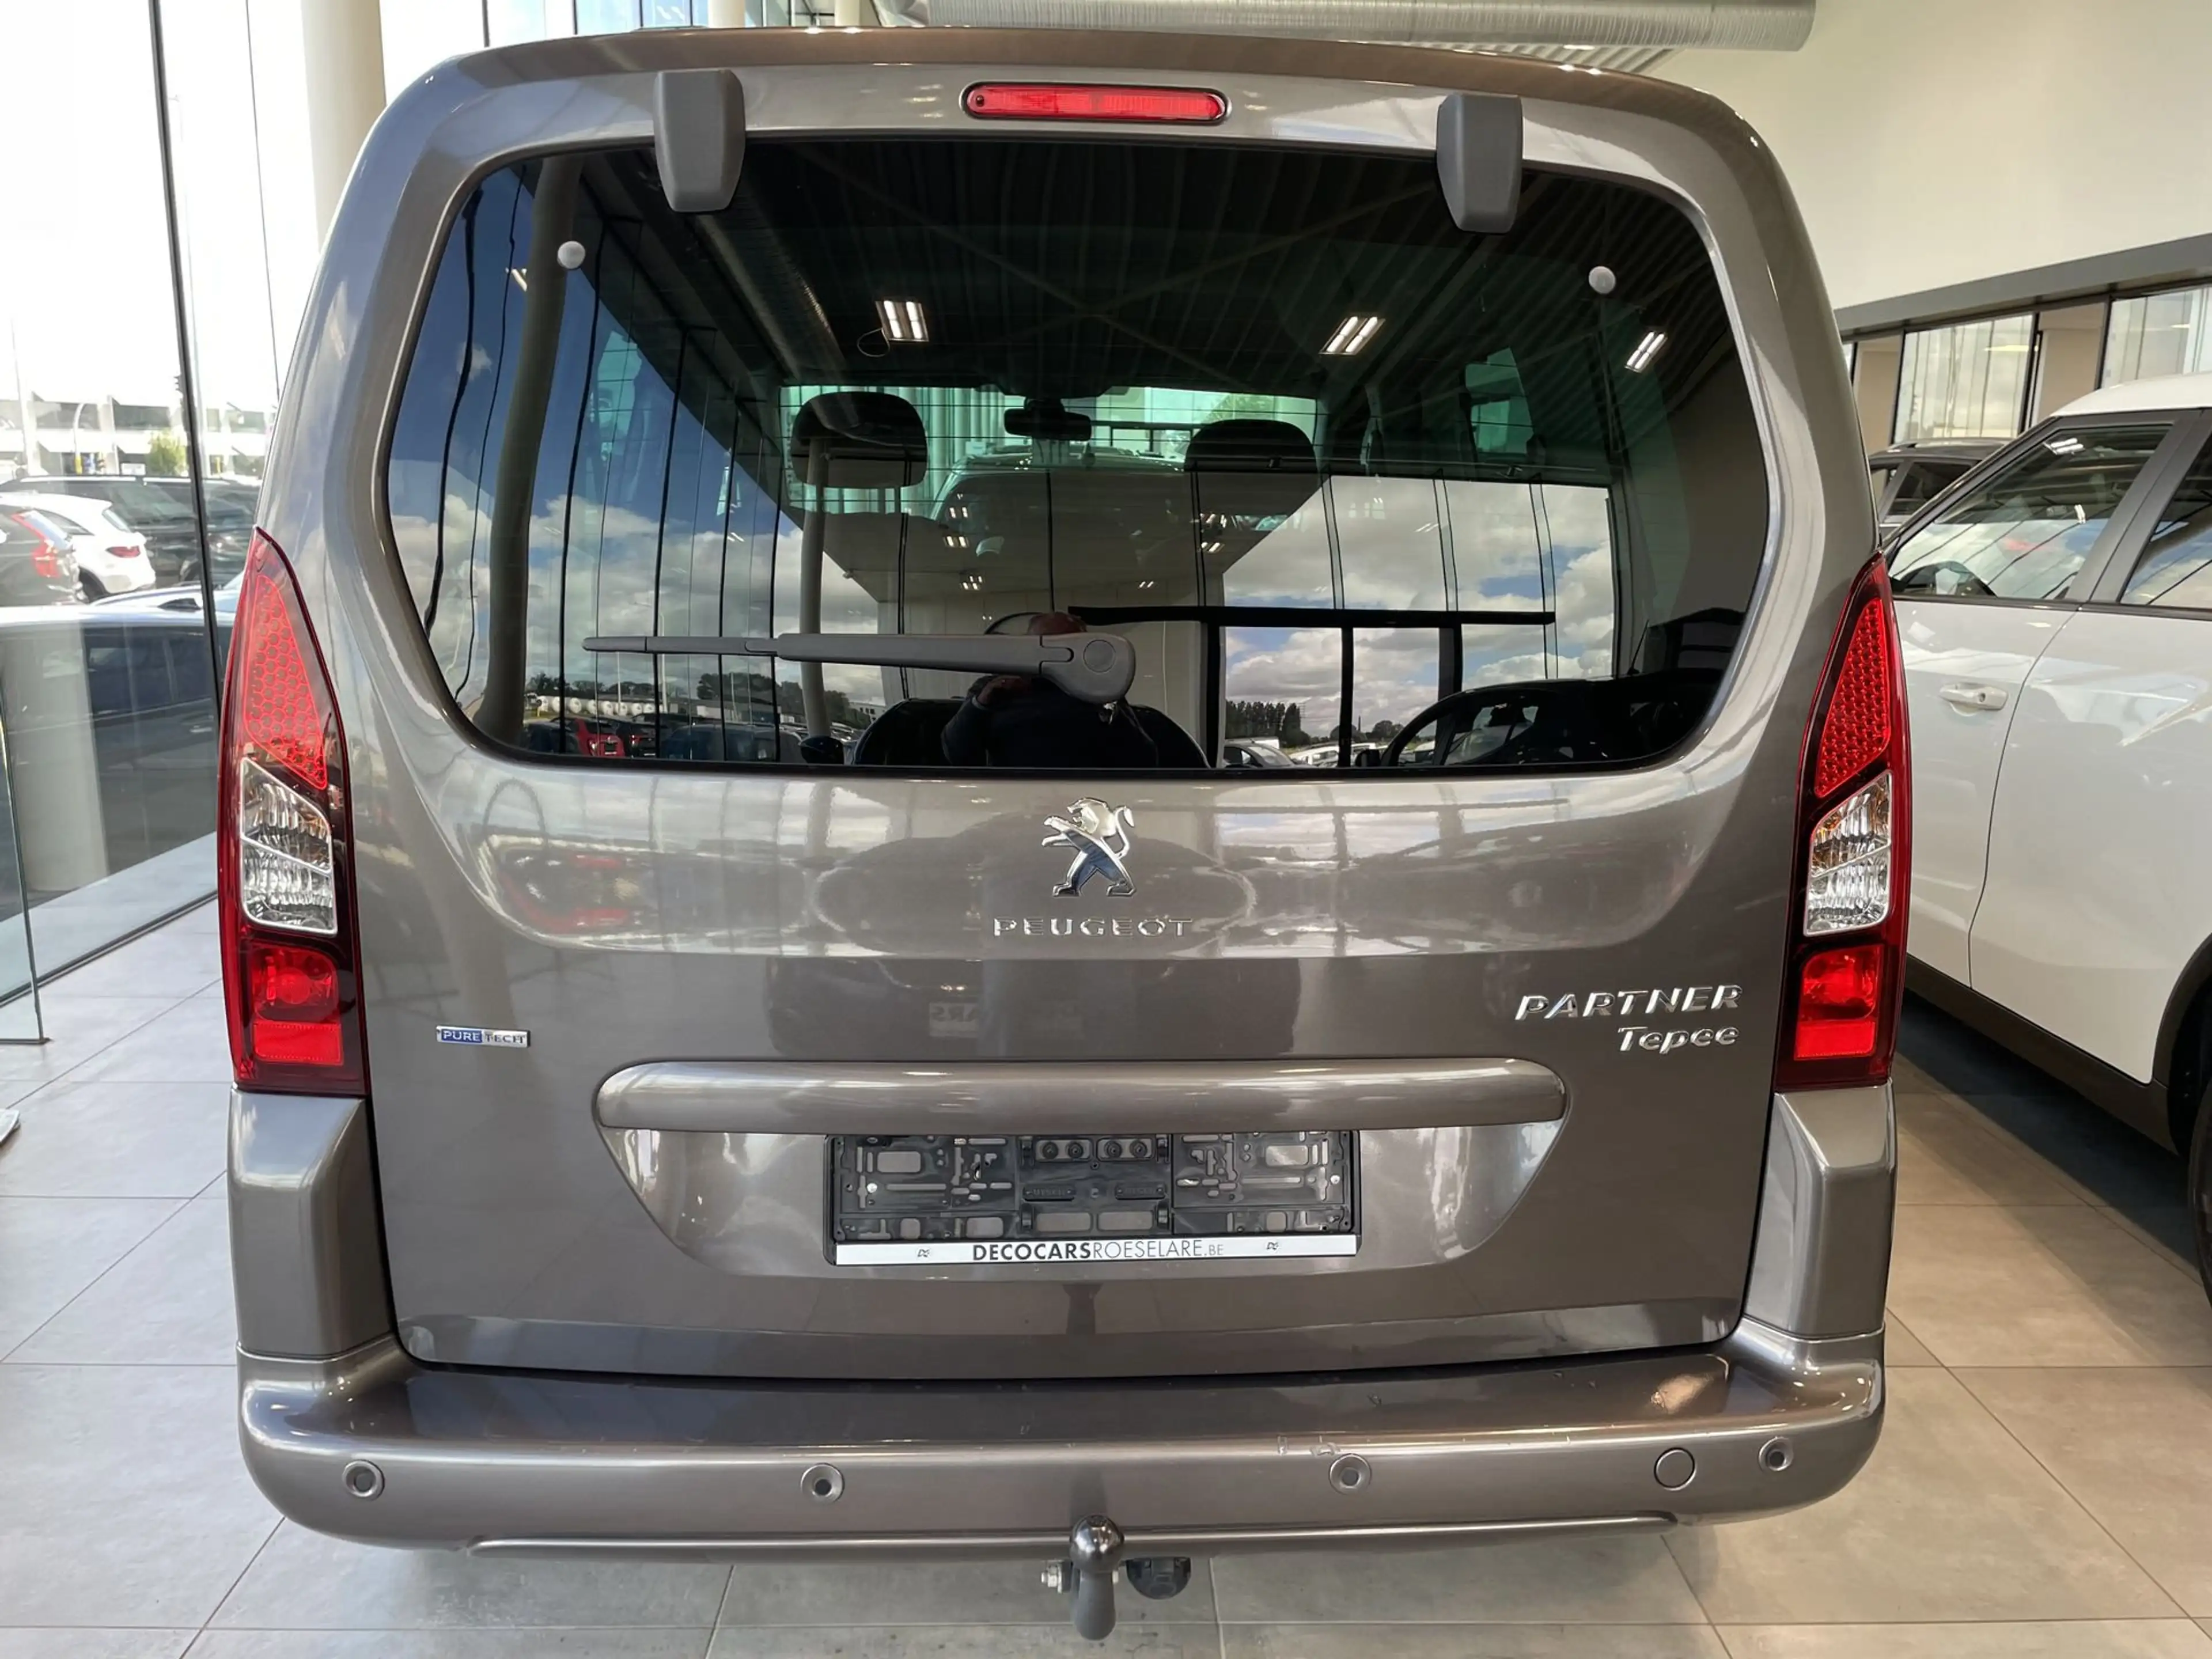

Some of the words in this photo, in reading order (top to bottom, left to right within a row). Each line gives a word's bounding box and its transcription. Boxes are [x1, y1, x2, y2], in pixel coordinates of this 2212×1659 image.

[993, 917, 1192, 937] PEUGEOT
[1515, 984, 1743, 1020] PARTNER
[1618, 1027, 1740, 1054] Tepee
